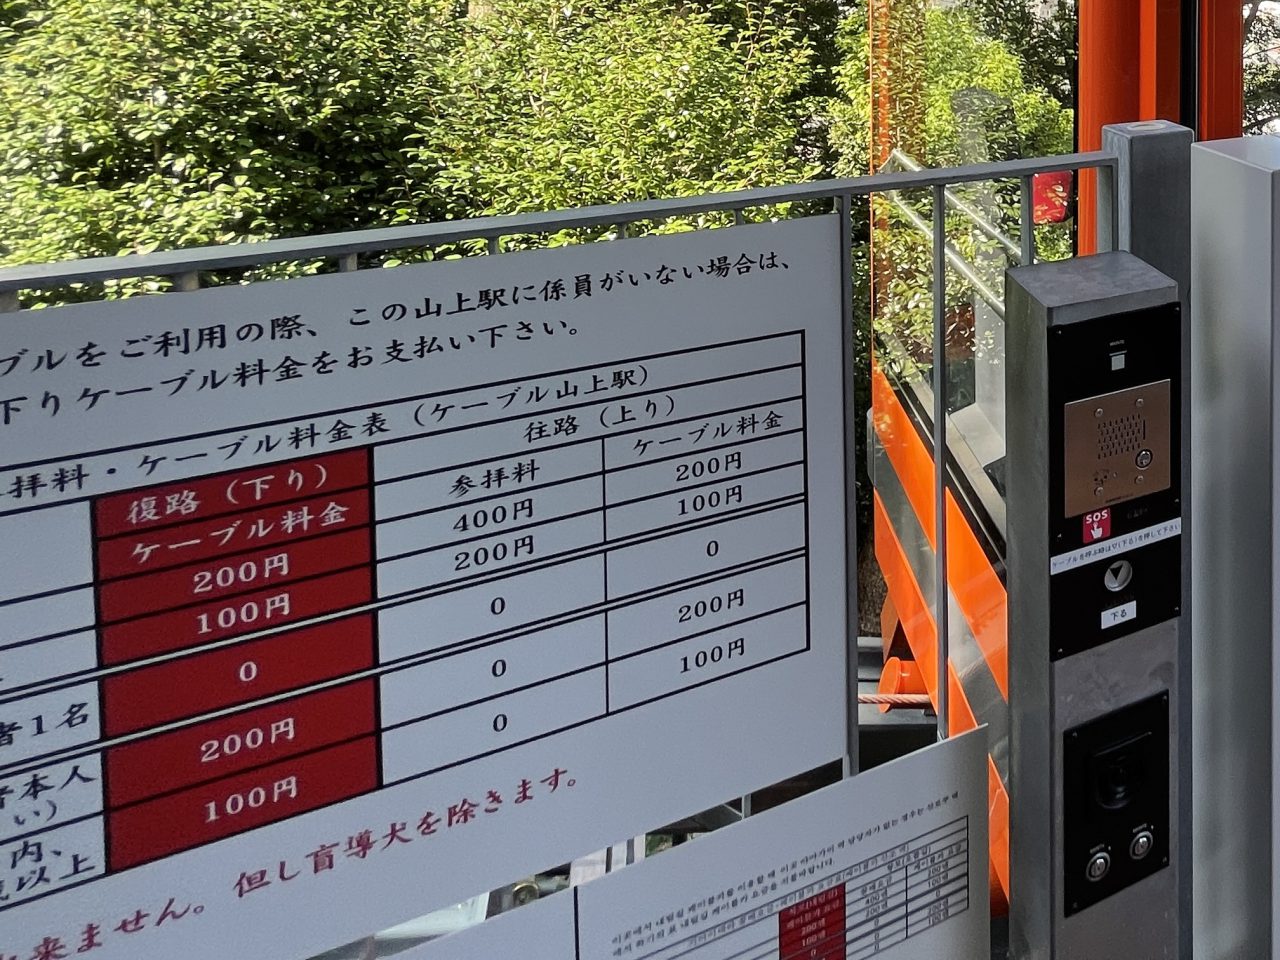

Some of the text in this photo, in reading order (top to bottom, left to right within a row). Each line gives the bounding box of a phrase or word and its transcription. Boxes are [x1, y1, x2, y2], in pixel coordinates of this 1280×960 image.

[0, 365, 648, 498] 拝料・ケーブル料金表（ケーブル山上駅）
[633, 411, 784, 456] ケーブル料金
[449, 459, 540, 498] 参拝料
[675, 451, 742, 482] 200円
[453, 498, 534, 533] 400円
[678, 484, 743, 516] 100円
[1085, 510, 1109, 525] SOS
[132, 502, 350, 563] ケーブル料金
[706, 540, 719, 558] 0
[454, 534, 535, 571] 200円
[194, 553, 290, 593] 200円
[197, 593, 290, 634] 100円
[491, 596, 506, 616] 0
[677, 588, 745, 624] 200円
[1110, 608, 1127, 621] 下る
[239, 661, 258, 682] 0
[492, 659, 507, 678] 0
[679, 637, 745, 675] 100円
[201, 717, 295, 762] 200円
[493, 713, 508, 732] 0
[204, 776, 297, 823] 100円
